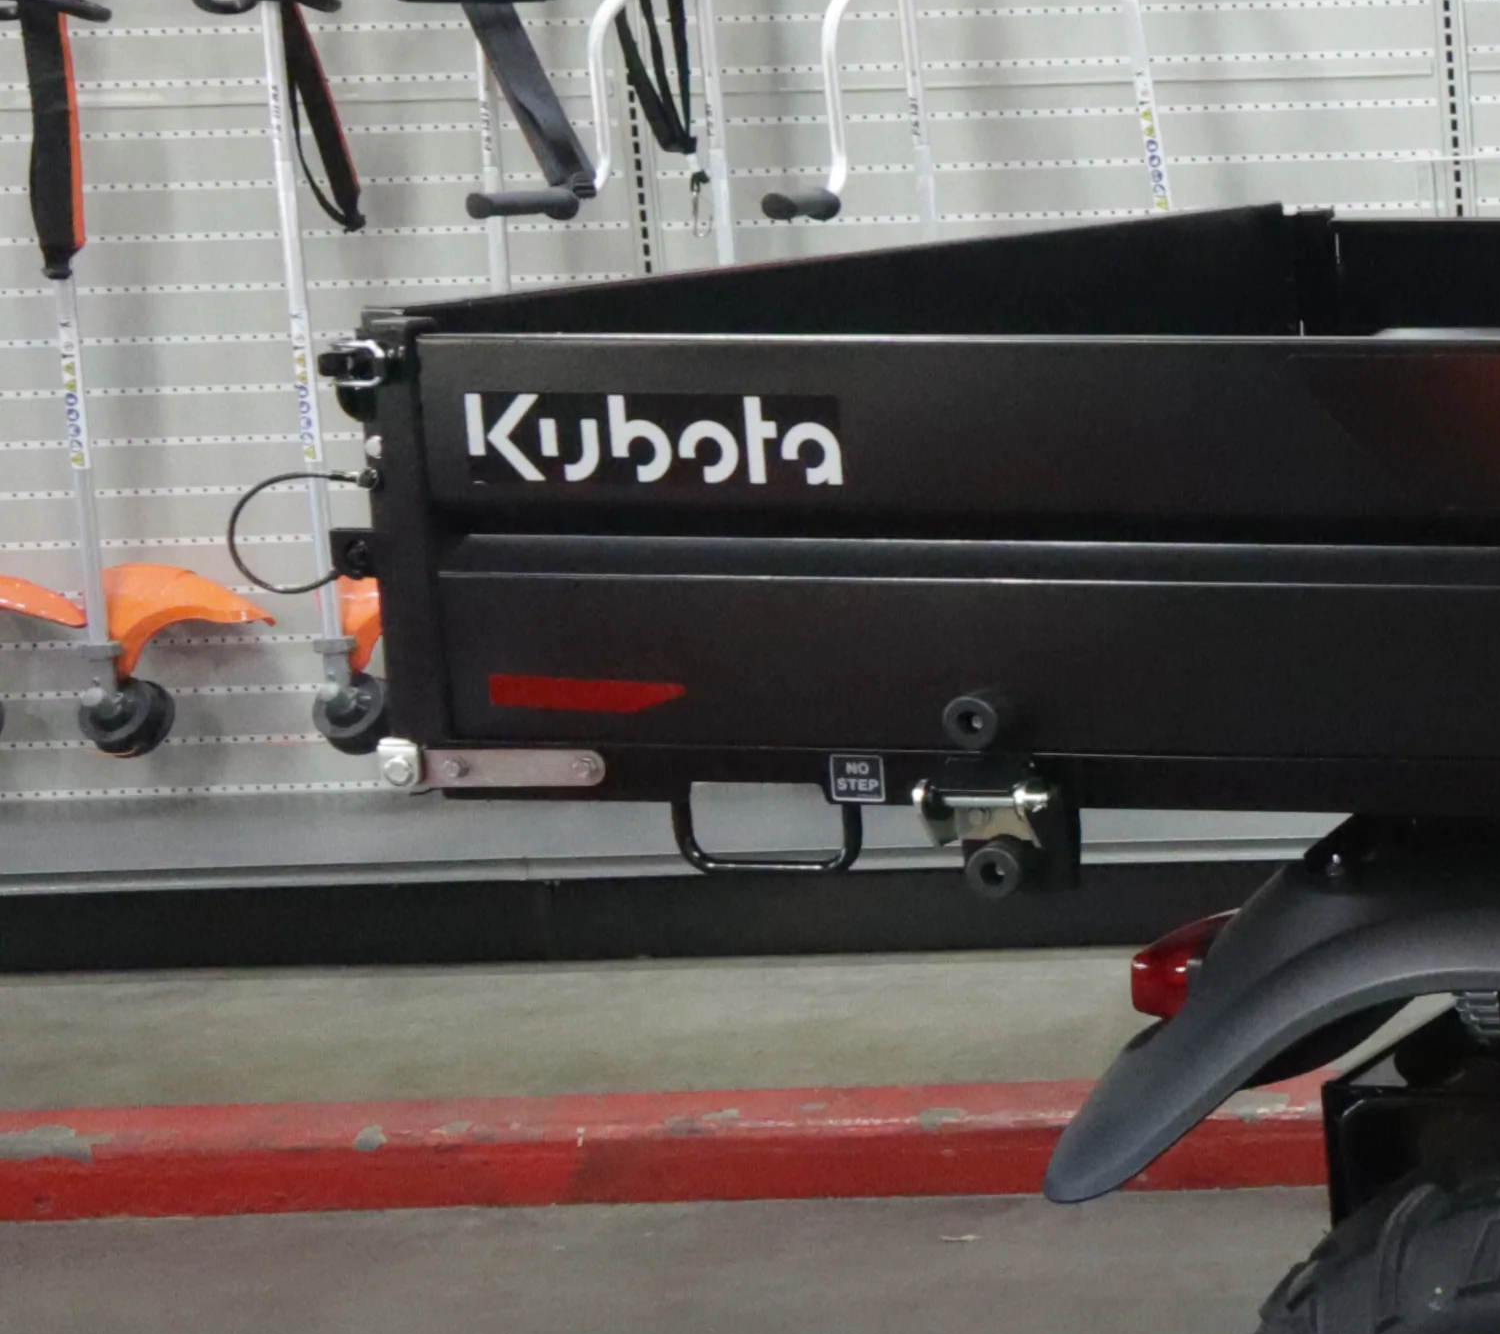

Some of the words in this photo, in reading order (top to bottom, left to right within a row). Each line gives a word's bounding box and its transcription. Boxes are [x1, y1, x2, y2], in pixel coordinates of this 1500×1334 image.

[464, 393, 843, 485] Kubota
[845, 761, 870, 775] NO
[836, 778, 879, 792] STEP
